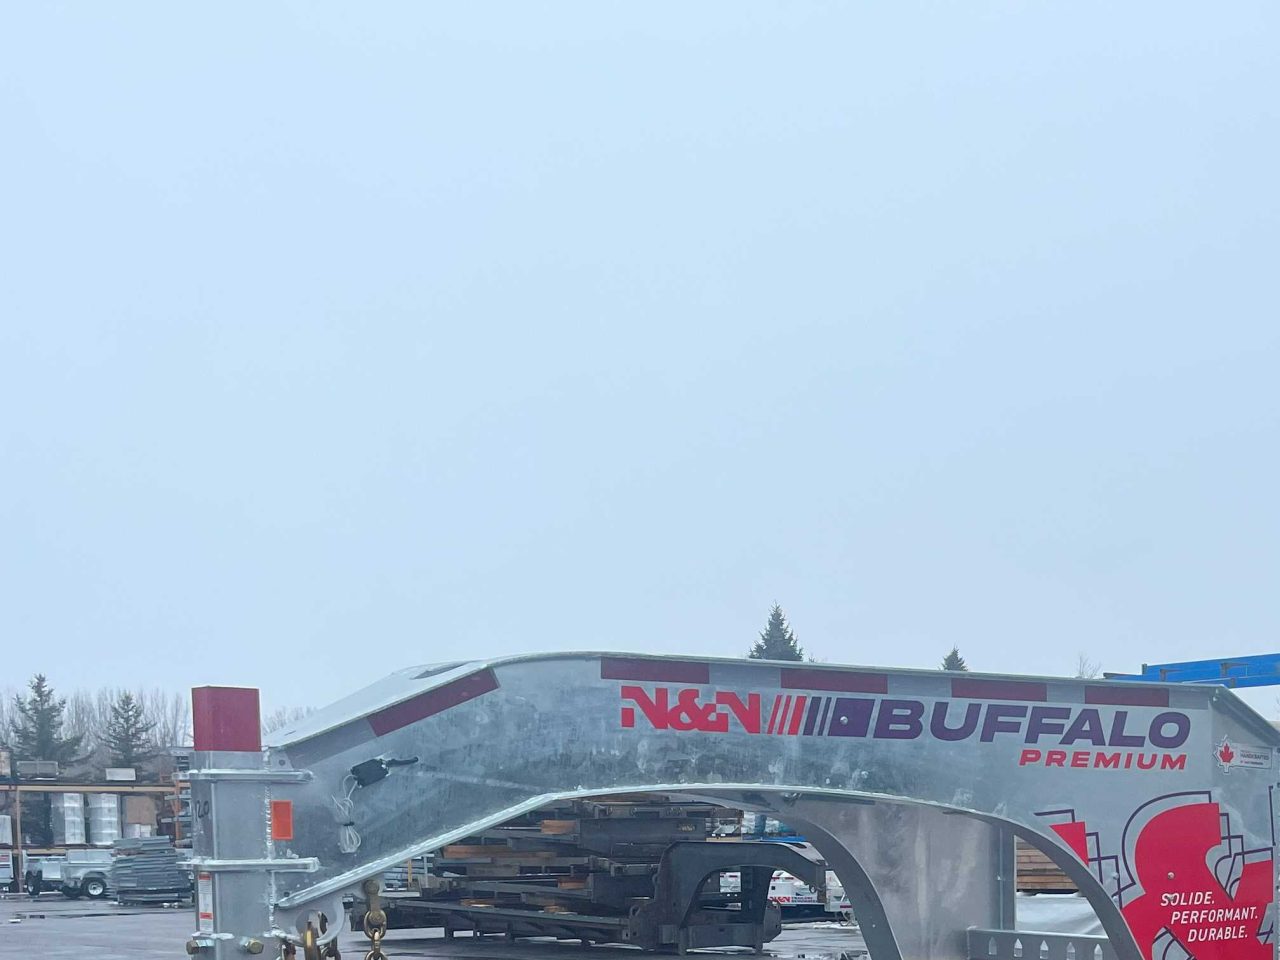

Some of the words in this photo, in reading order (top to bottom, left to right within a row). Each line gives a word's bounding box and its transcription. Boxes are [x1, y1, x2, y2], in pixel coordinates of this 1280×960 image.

[621, 685, 760, 734] N&N
[873, 699, 1190, 749] BUFFALO
[1019, 749, 1187, 770] PREMIUM
[1161, 891, 1215, 906] SOLIDE.
[1171, 907, 1258, 924] PERFORMANT.
[1188, 926, 1248, 942] DURABLE.
